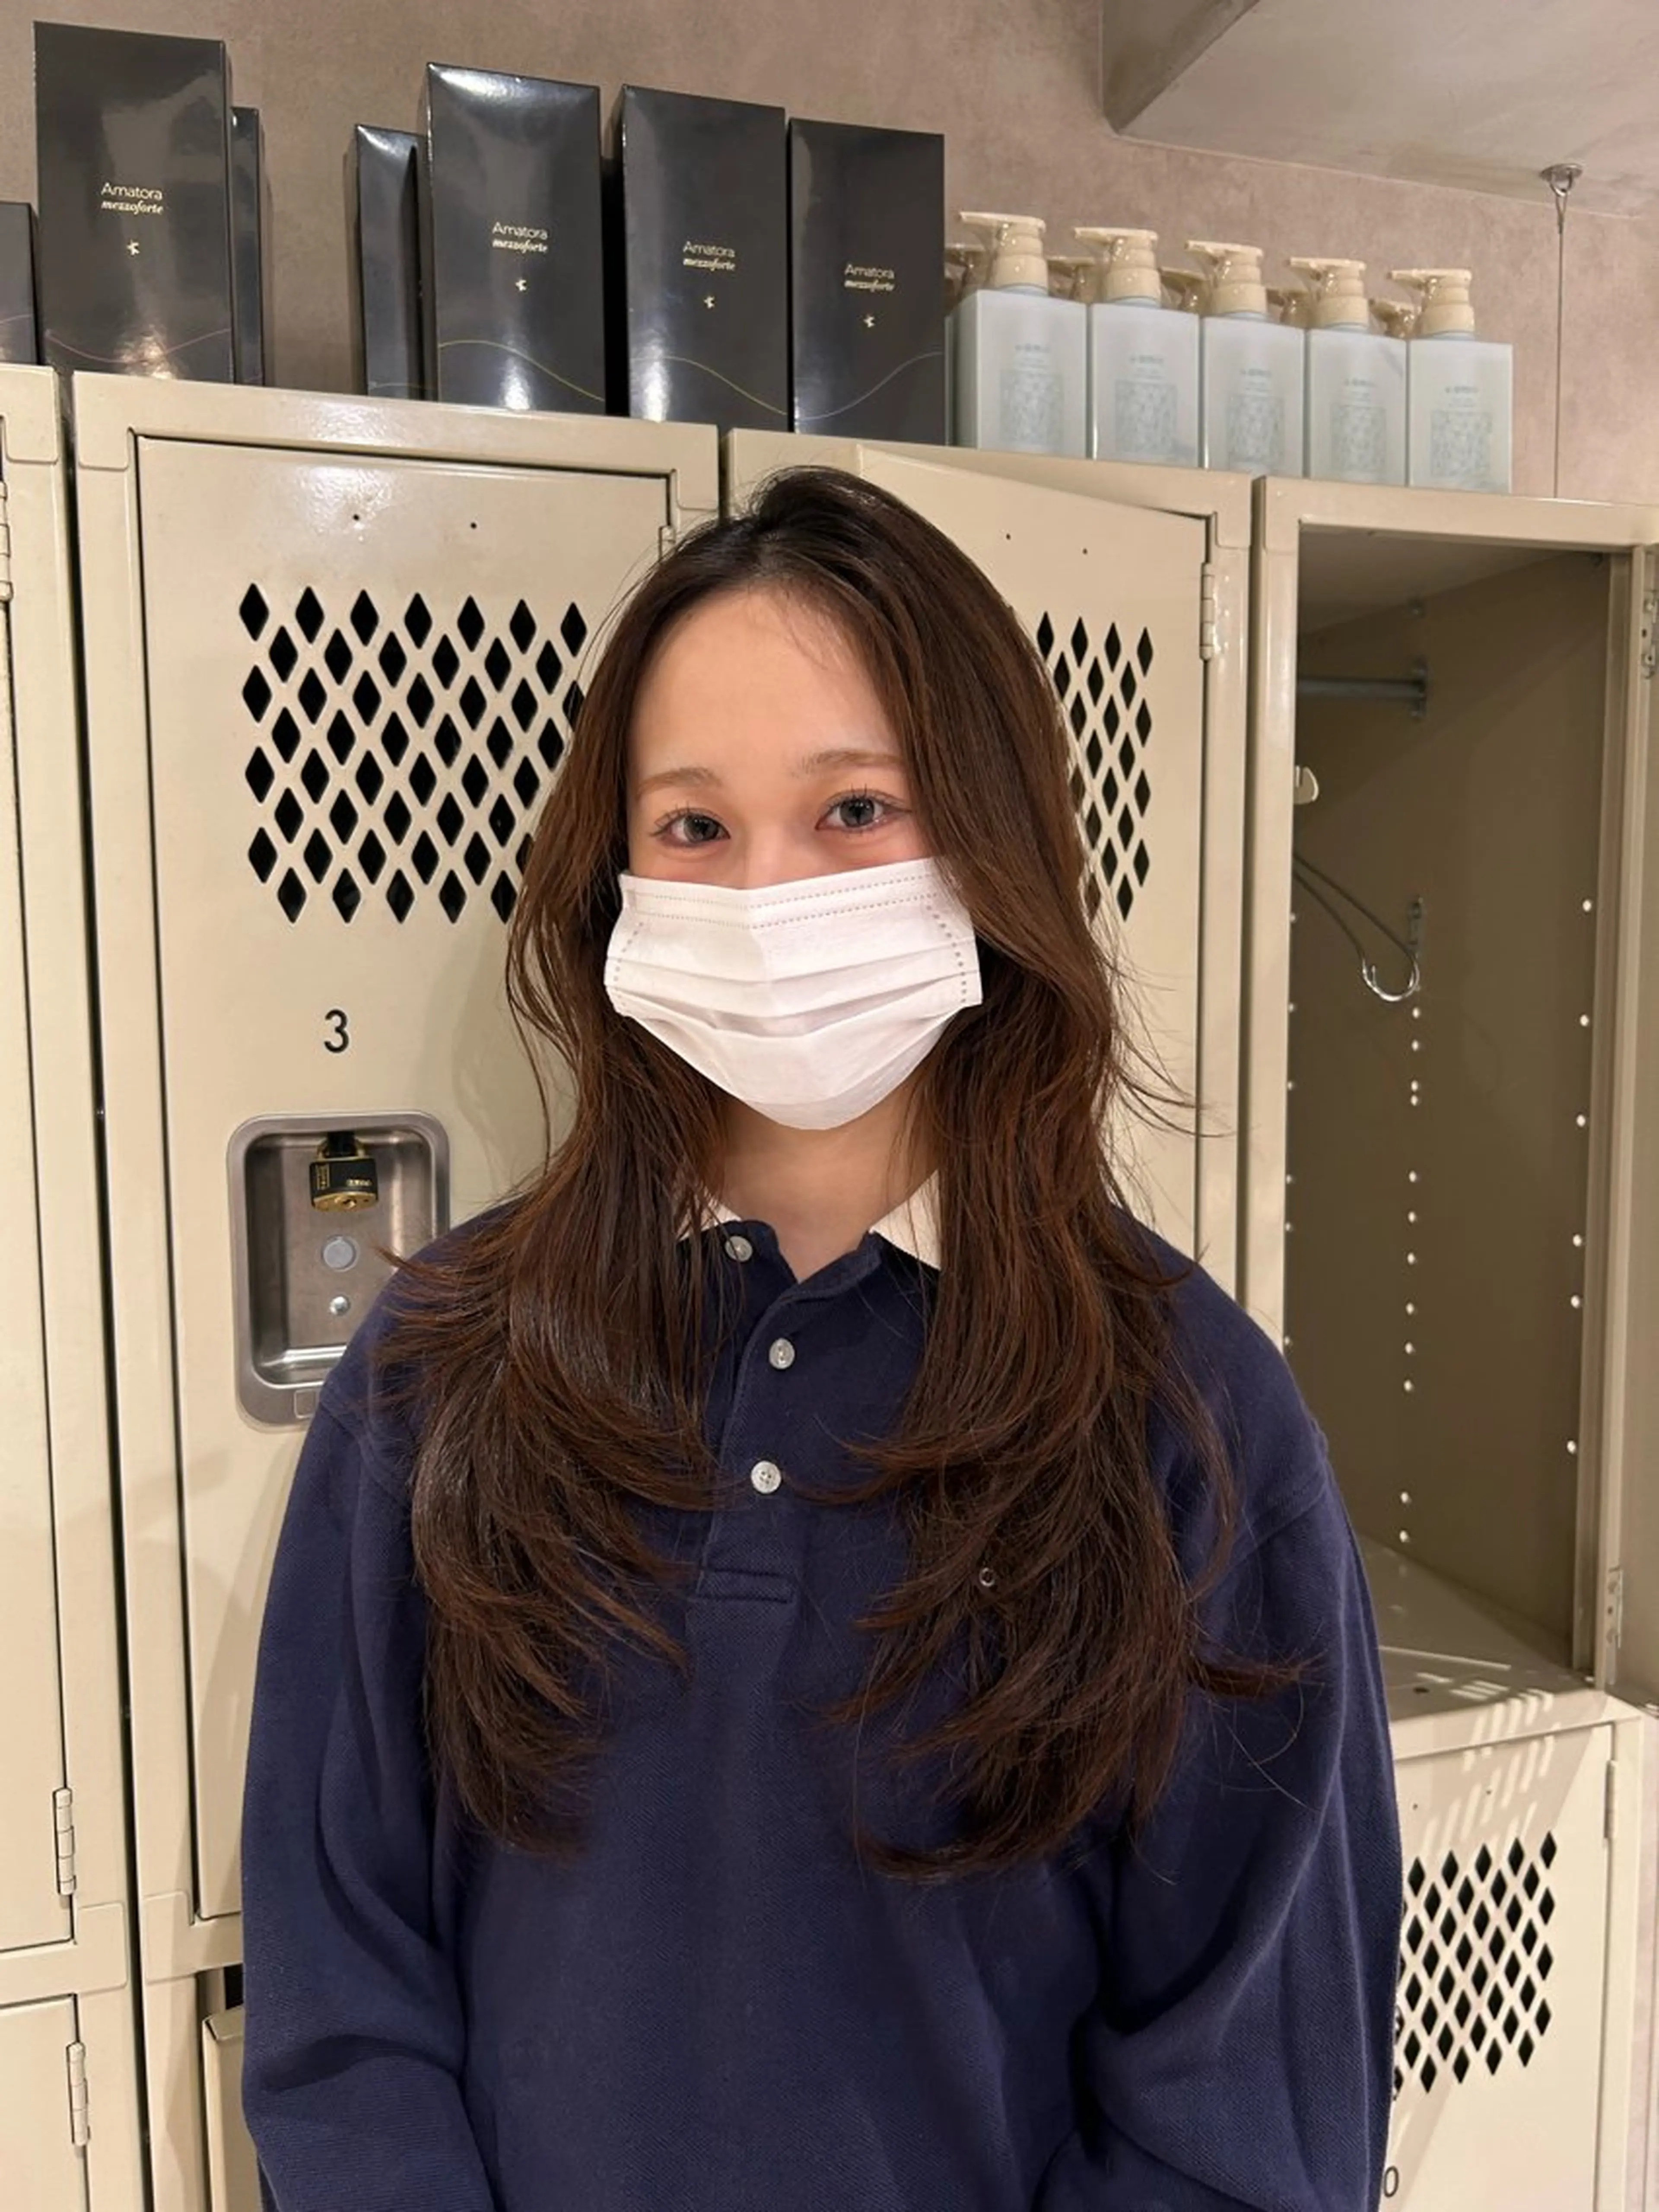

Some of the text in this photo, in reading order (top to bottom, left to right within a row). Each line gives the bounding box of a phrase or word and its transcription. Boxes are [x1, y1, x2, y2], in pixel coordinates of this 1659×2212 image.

[101, 182, 162, 200] Amatora
[101, 200, 163, 215] mezzoforte
[493, 222, 547, 240] Amatora
[493, 239, 548, 254] mezzoforte
[683, 241, 735, 257] Amatora
[844, 264, 894, 279] Amatora
[324, 1009, 349, 1053] 3
